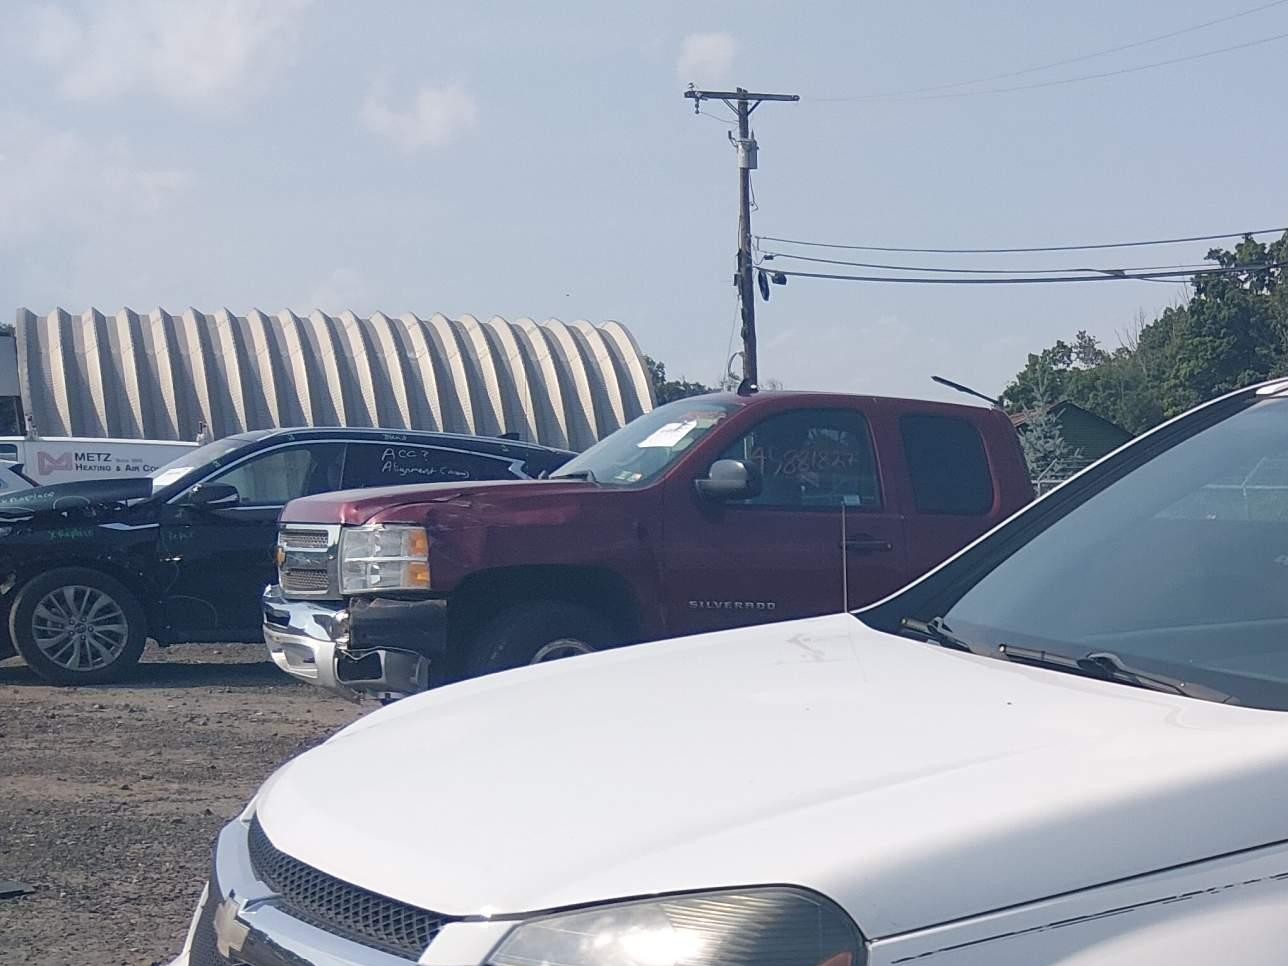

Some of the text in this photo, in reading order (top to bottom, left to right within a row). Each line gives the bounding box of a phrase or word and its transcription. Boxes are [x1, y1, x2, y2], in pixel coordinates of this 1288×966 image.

[74, 452, 112, 462] METZ
[116, 464, 121, 472] &
[688, 600, 777, 610] SILVERADO
